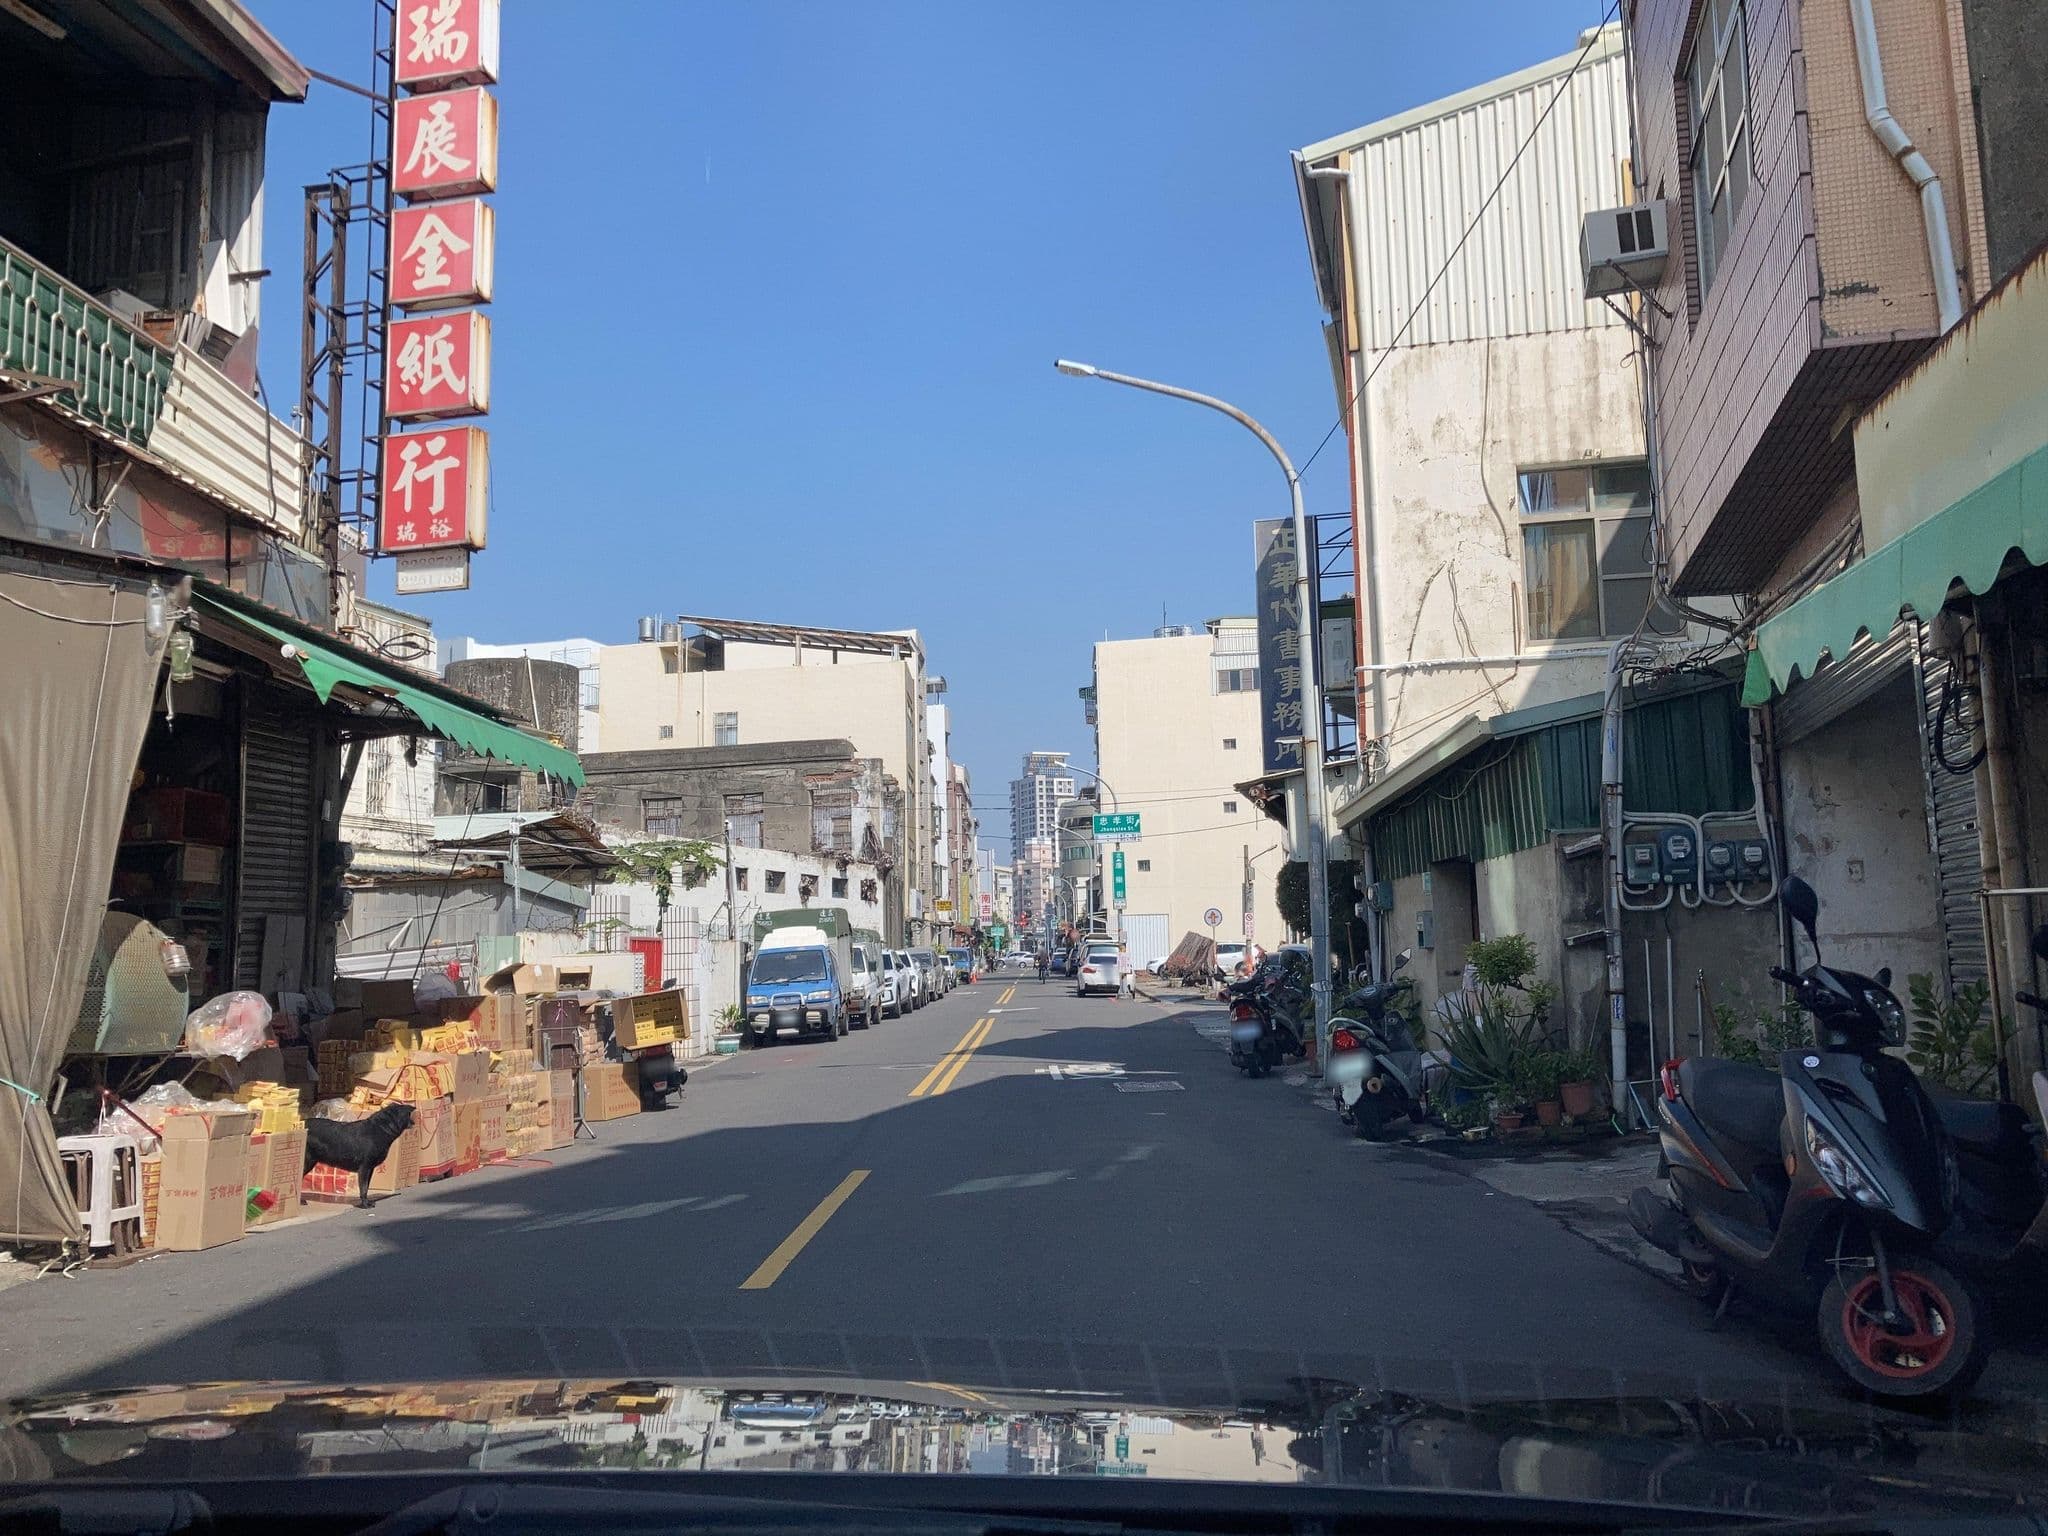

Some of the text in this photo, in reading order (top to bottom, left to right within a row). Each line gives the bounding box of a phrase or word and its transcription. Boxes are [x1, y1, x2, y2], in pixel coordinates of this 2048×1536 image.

[391, 0, 472, 515] 瑞展金紙行
[1099, 816, 1135, 826] 忠孝街
